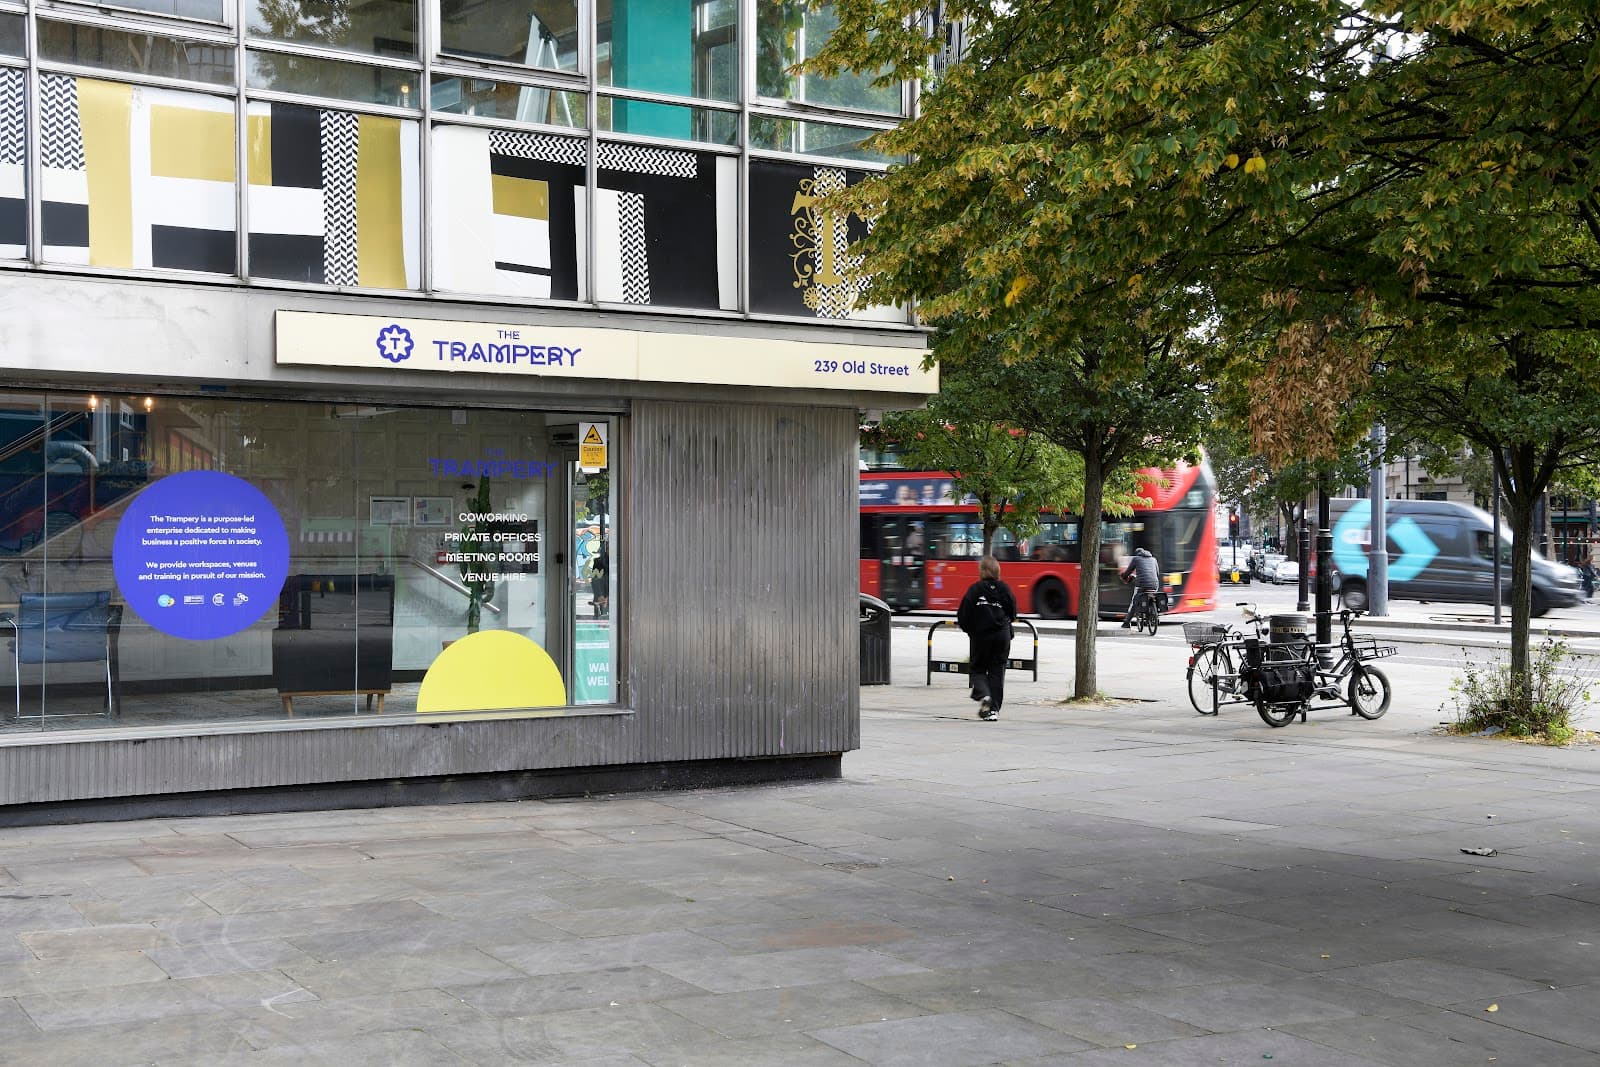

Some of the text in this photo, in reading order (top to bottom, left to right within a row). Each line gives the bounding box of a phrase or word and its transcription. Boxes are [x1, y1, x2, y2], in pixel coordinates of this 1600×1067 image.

[497, 330, 520, 340] THE
[432, 340, 582, 367] TRAMPERY
[814, 360, 910, 376] 239 Old Street
[429, 457, 559, 479] TRAMPERY
[165, 515, 199, 524] Trampery
[458, 513, 528, 523] COWORKING
[146, 526, 183, 535] enterprise
[184, 526, 220, 534] dedicated
[230, 526, 256, 535] making
[180, 538, 207, 546] positive
[444, 532, 542, 542] PRIVATE OFFICES
[446, 552, 541, 562] MEETING ROOMS
[146, 561, 158, 569] We
[160, 561, 187, 569] provide
[154, 572, 181, 581] training
[191, 572, 216, 580] pursuit
[460, 572, 528, 582] VENUE HIRE
